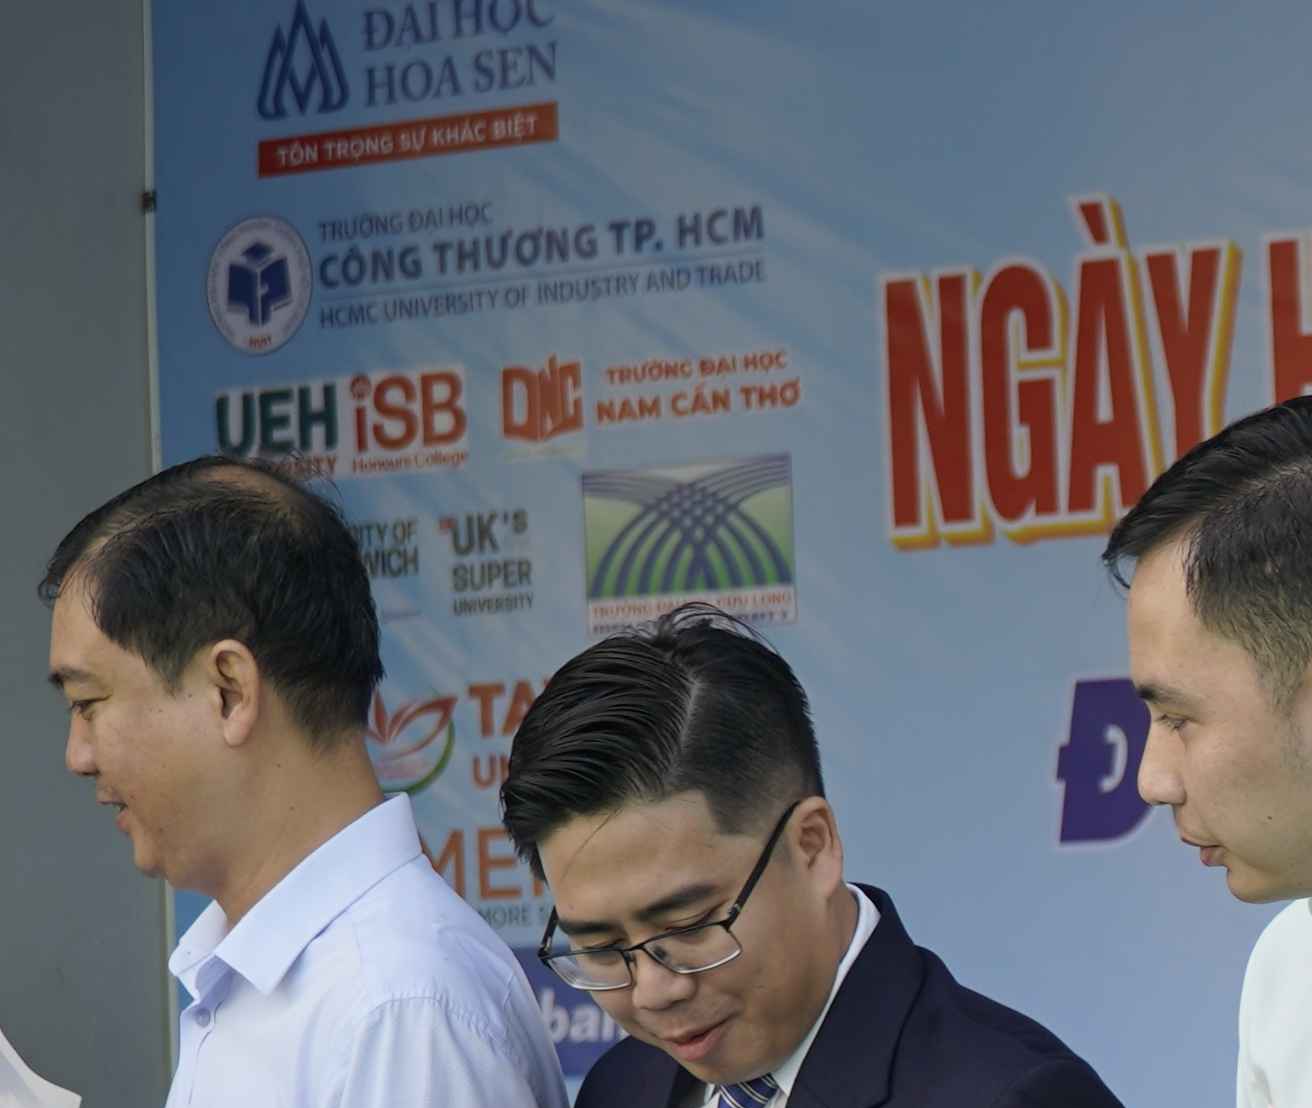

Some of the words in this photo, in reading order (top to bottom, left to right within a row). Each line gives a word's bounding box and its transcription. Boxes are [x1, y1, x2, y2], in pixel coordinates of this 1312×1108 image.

[362, 0, 443, 53] ĐẠI
[363, 56, 463, 109] HOA
[471, 41, 559, 97] SEN
[276, 139, 319, 168] TÔN
[324, 134, 395, 162] TRỌNG
[398, 124, 428, 154] SỰ
[432, 115, 487, 149] KHÁC
[492, 111, 539, 142] BIỆT
[408, 208, 443, 234] ĐẠI
[449, 199, 494, 230] HỌC
[319, 245, 423, 292] CÔNG
[433, 222, 599, 279] THƯƠNG
[609, 216, 665, 256] TP.
[675, 202, 766, 250] HCM
[320, 300, 379, 330] HCMC
[384, 288, 498, 322] UNIVERSITY
[503, 285, 529, 311] OF
[537, 270, 640, 306] INDUSTRY
[646, 266, 693, 294] AND
[697, 257, 766, 287] TRADE
[606, 361, 693, 386] TRƯỜNG
[698, 355, 738, 379] ĐẠI
[743, 350, 790, 375] HỌC
[880, 198, 1236, 540] NGÀY
[215, 381, 339, 456] UEH
[595, 394, 662, 425] NAM
[739, 376, 802, 412] THƠ
[452, 557, 533, 593] SUPER
[453, 592, 535, 616] UNIVERSITY
